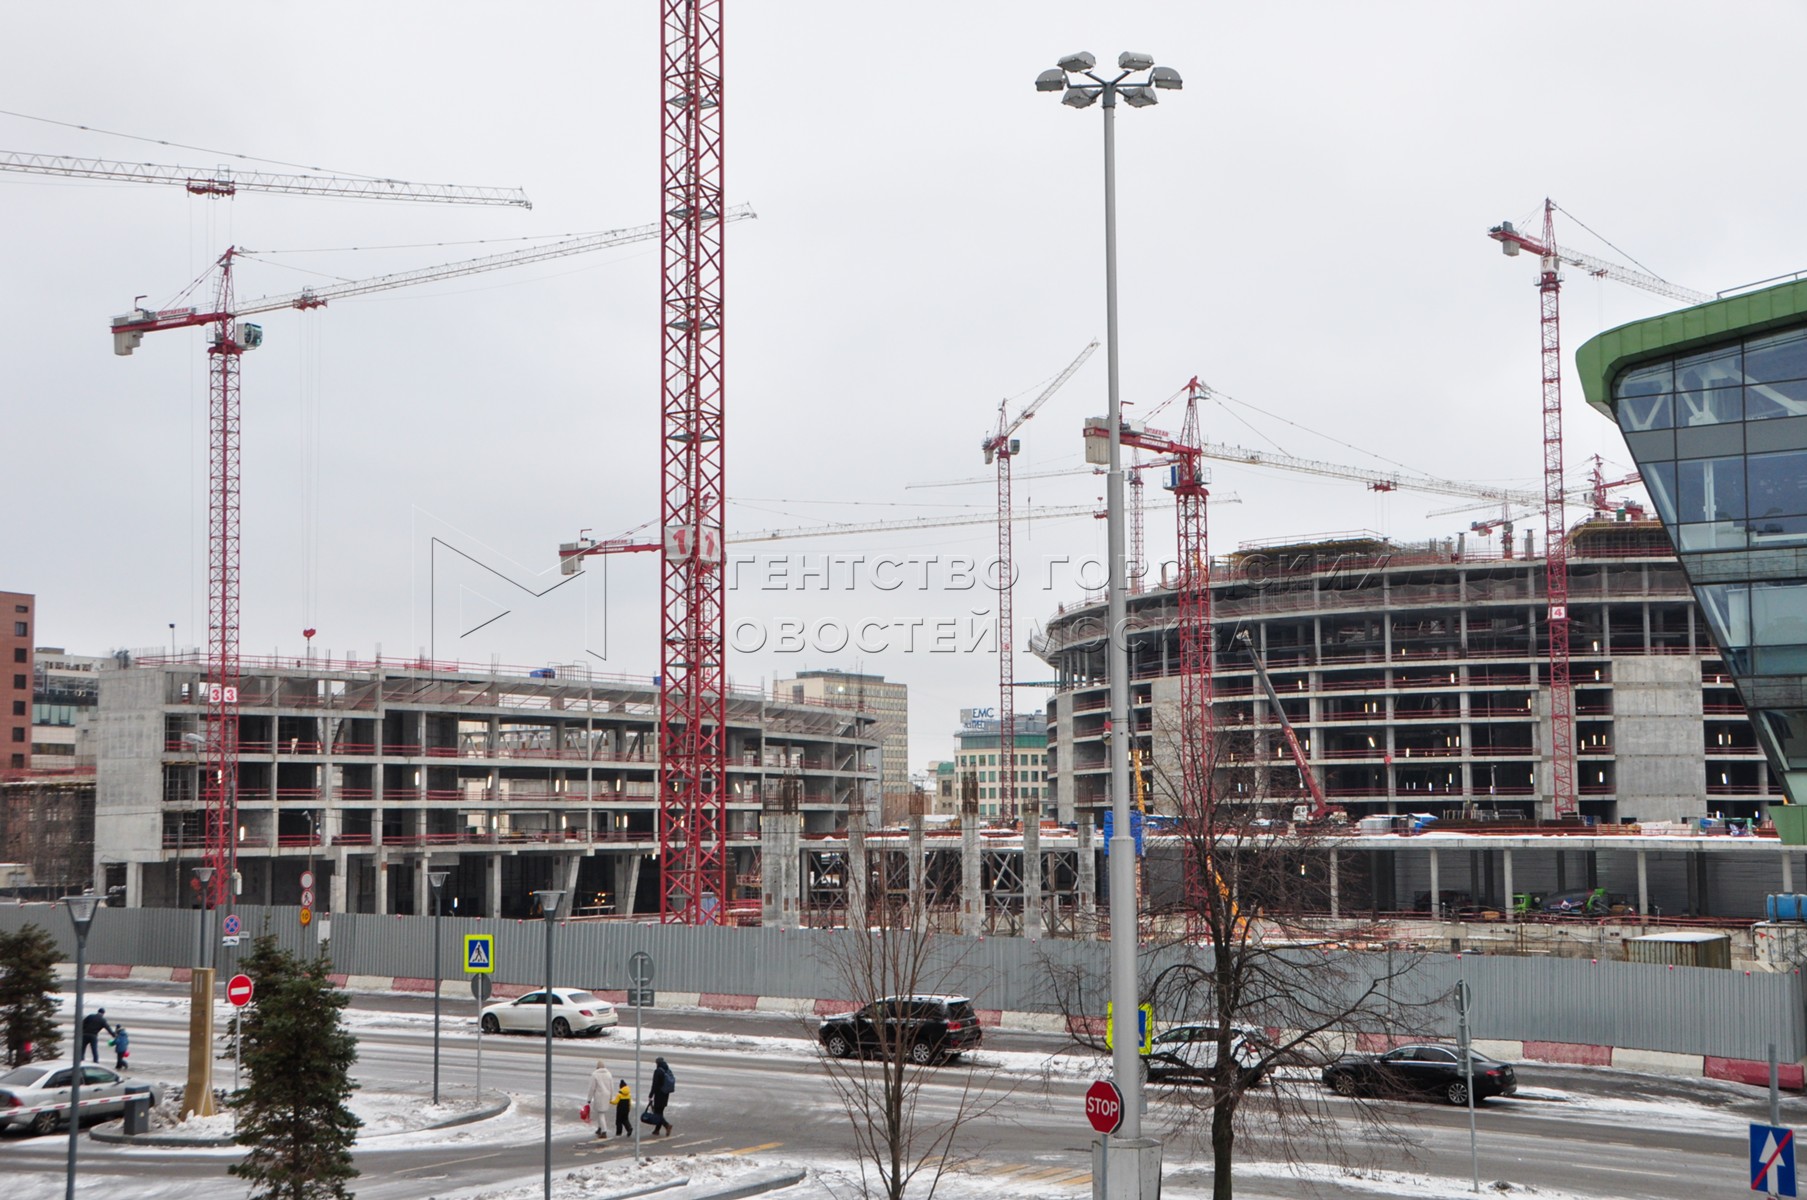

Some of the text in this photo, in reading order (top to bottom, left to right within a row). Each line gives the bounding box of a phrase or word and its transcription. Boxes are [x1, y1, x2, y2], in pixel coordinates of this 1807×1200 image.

[1554, 608, 1562, 616] 4
[212, 689, 220, 701] 3
[226, 689, 235, 701] 3
[973, 708, 994, 718] EMC
[1087, 1096, 1118, 1117] STOP
